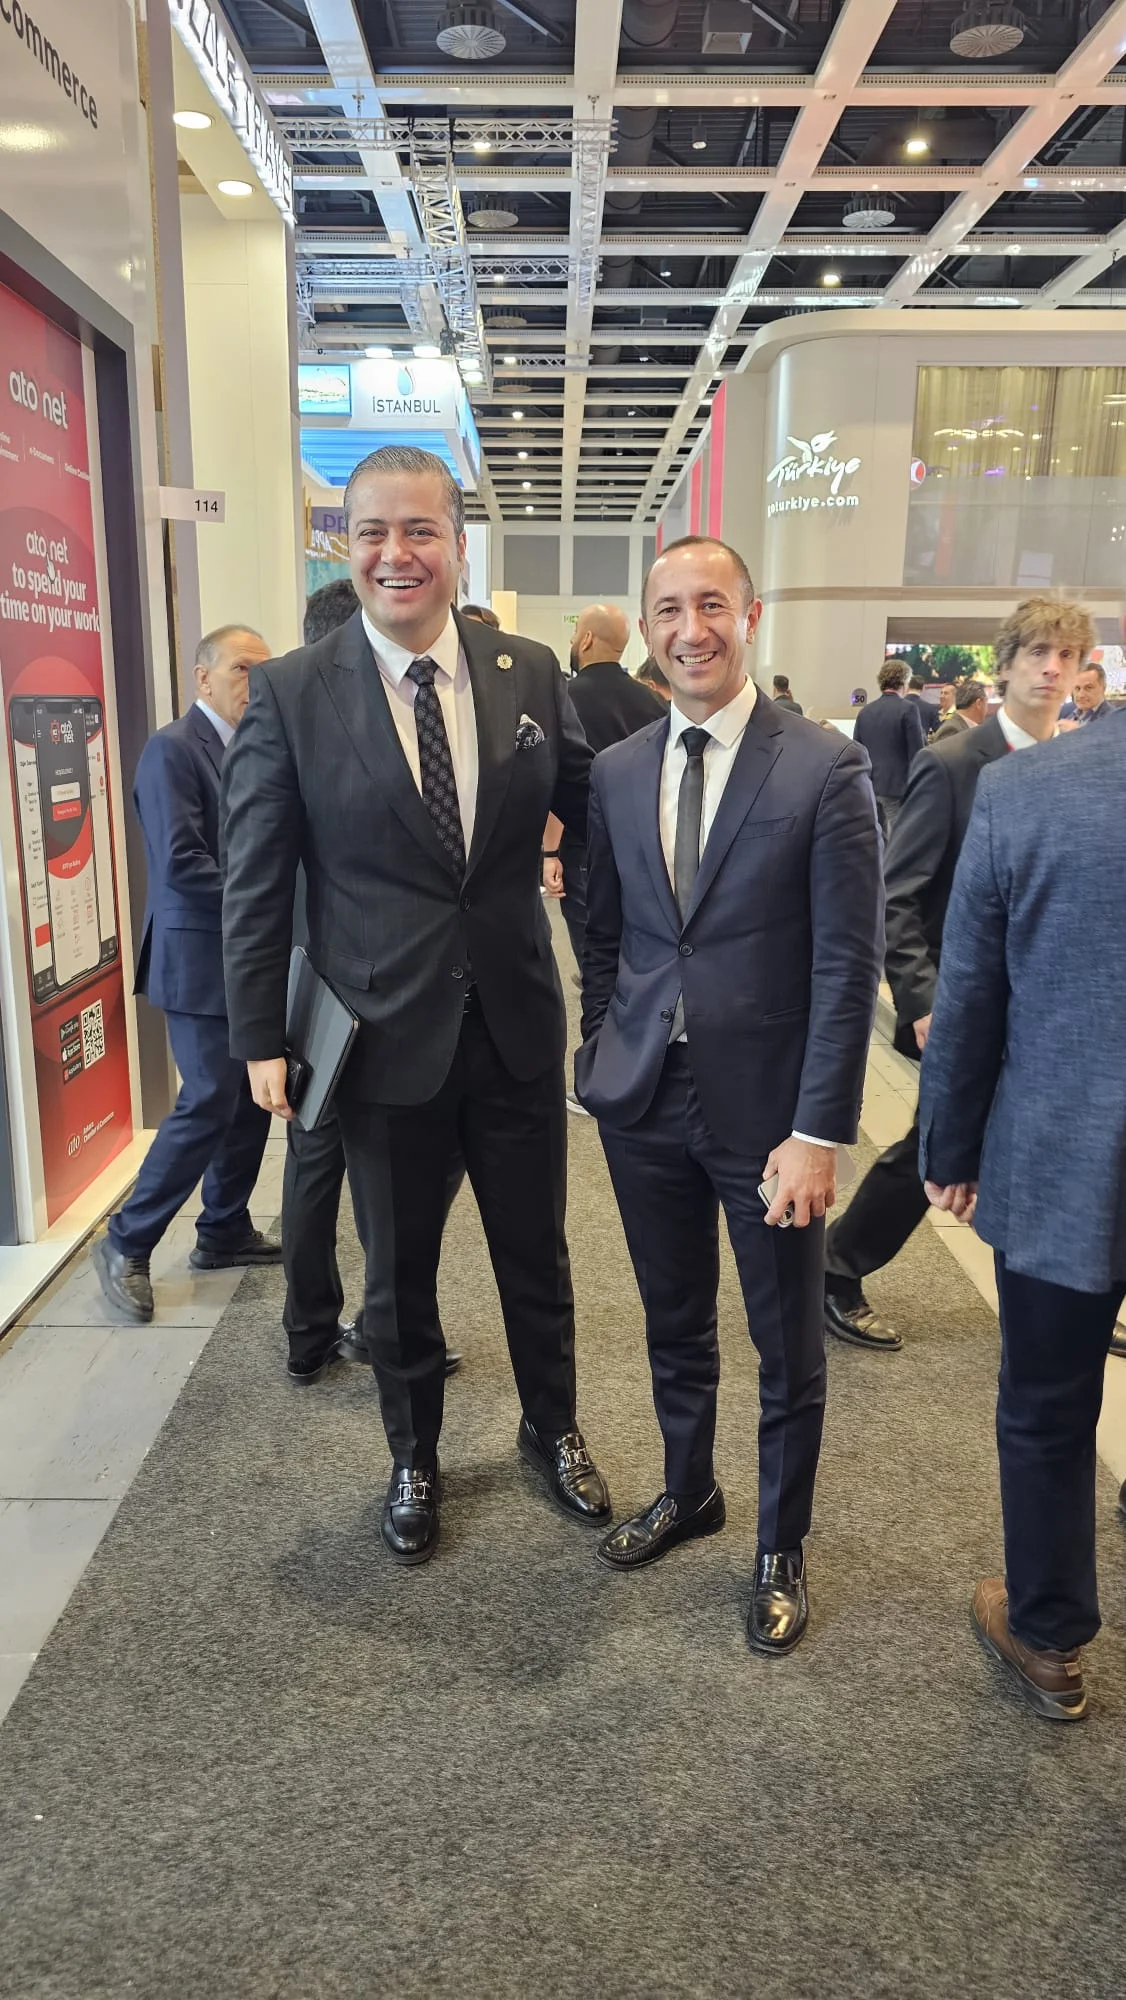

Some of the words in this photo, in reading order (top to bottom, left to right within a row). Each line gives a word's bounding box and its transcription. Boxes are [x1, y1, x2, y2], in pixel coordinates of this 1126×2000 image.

[9, 371, 39, 411] ato
[42, 391, 68, 430] net
[372, 396, 441, 413] İSTANBUL
[194, 499, 218, 513] 114
[26, 530, 47, 557] ato
[50, 536, 69, 564] net
[12, 561, 26, 588] to
[28, 569, 62, 599] spend
[62, 578, 86, 605] your
[0, 590, 30, 622] time
[31, 602, 47, 624] on
[47, 605, 72, 632] your
[73, 606, 103, 632] work
